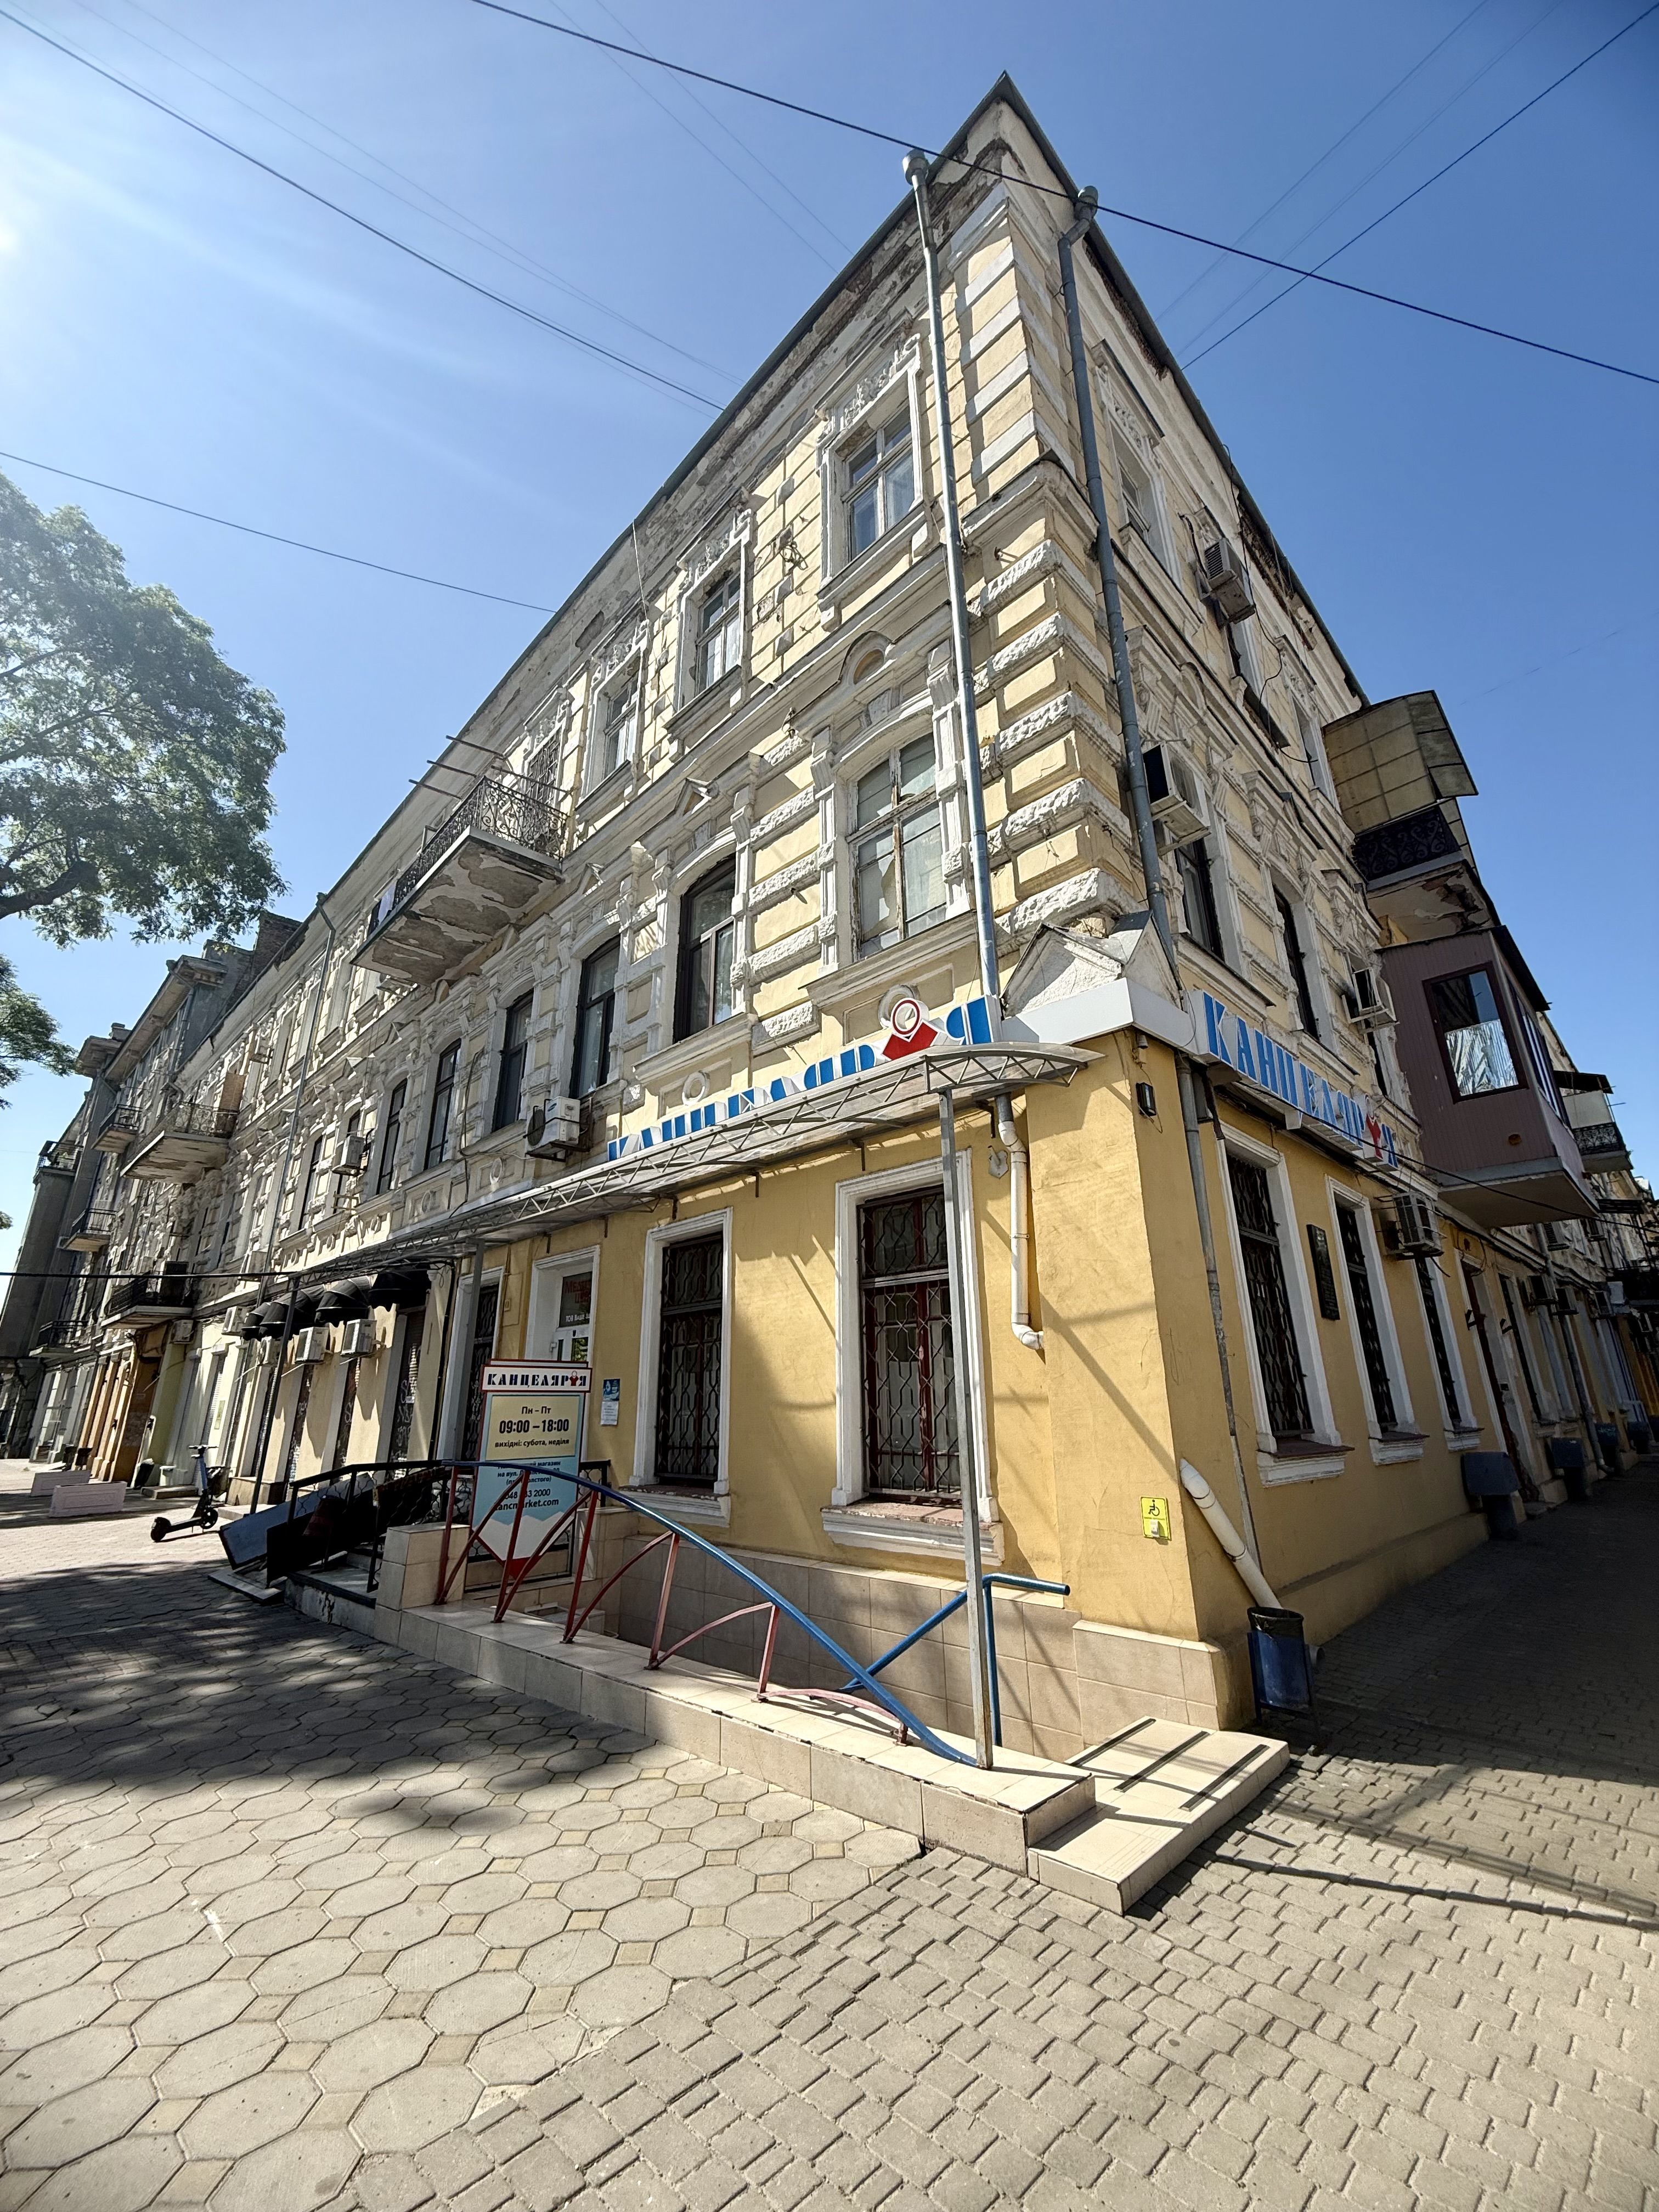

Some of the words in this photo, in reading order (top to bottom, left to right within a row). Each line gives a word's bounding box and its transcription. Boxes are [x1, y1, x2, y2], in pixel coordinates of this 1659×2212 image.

[487, 1371, 586, 1387] КАНЦЕЛЯРІЯ
[522, 1406, 533, 1414] Пн
[499, 1420, 530, 1434] 09:00
[542, 1419, 569, 1432] 18:00
[495, 1440, 522, 1448] вихідні:
[523, 1439, 547, 1448] субота,
[549, 1437, 569, 1446] неділя
[534, 1488, 551, 1497] 2000
[495, 1498, 559, 1511] ancmrket.com
